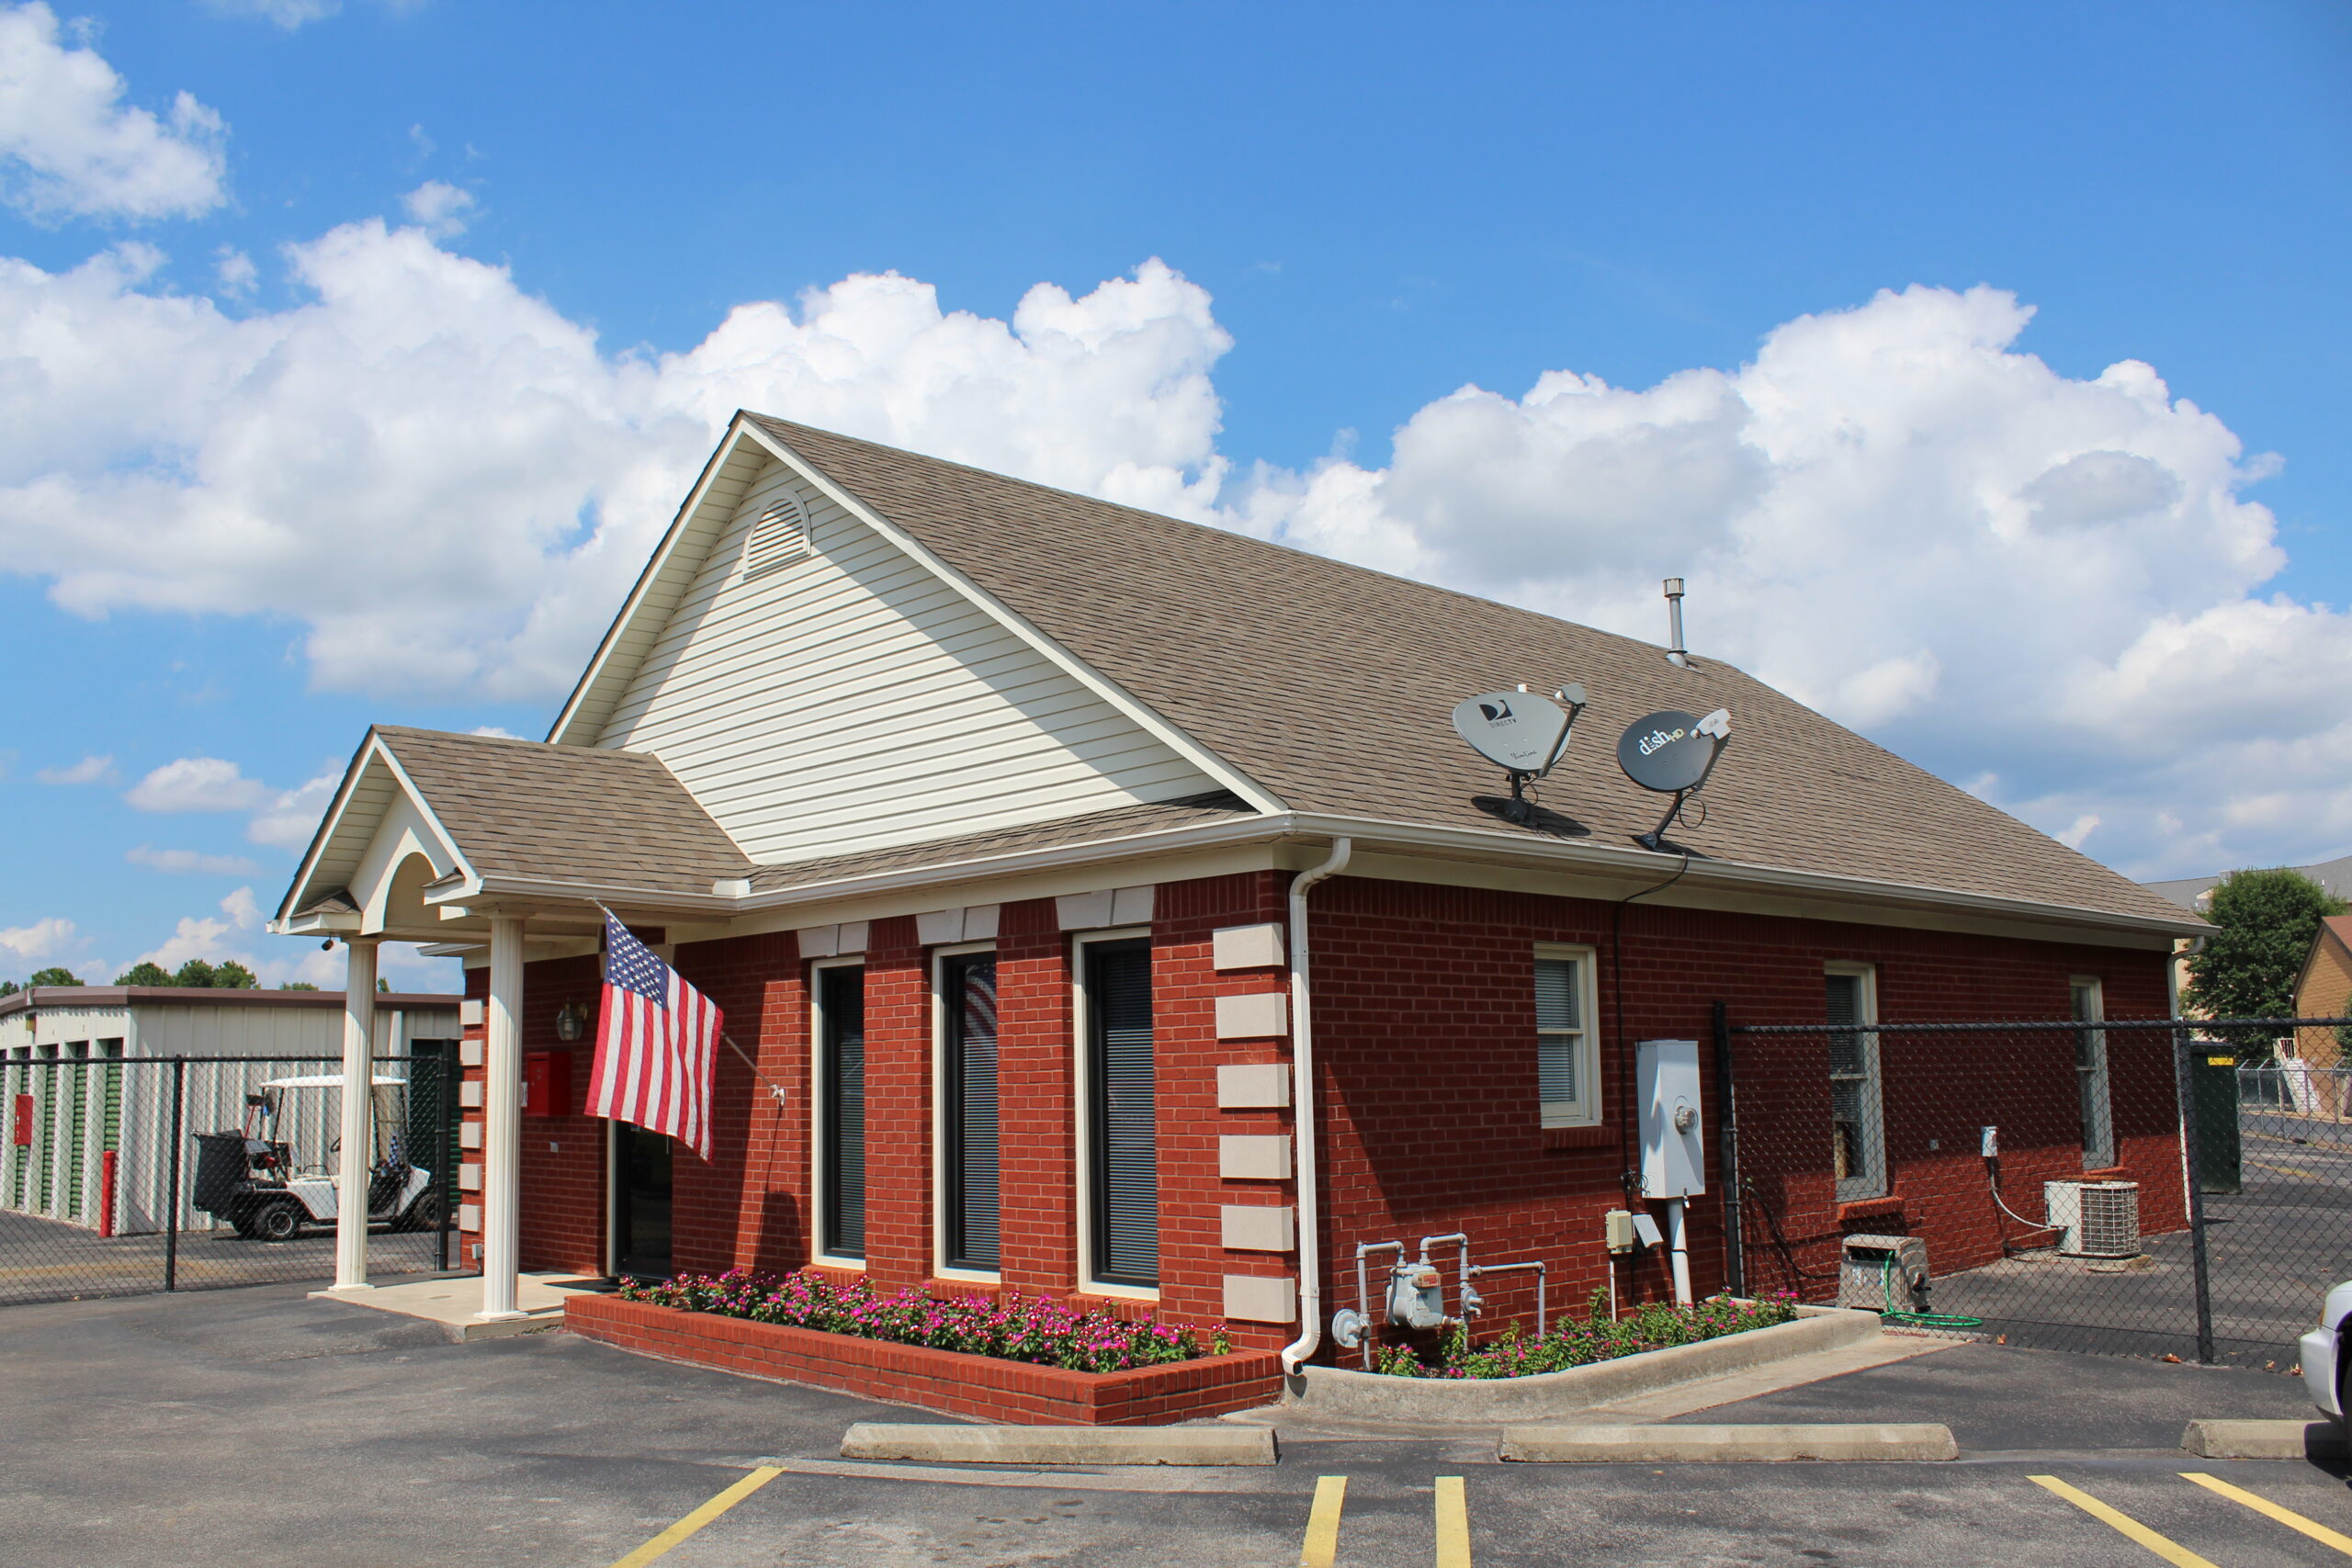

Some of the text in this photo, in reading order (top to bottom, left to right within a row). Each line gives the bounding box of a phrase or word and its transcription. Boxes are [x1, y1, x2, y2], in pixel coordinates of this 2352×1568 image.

[1488, 717, 1517, 728] DIRECTV
[1639, 728, 1685, 755] dish HD
